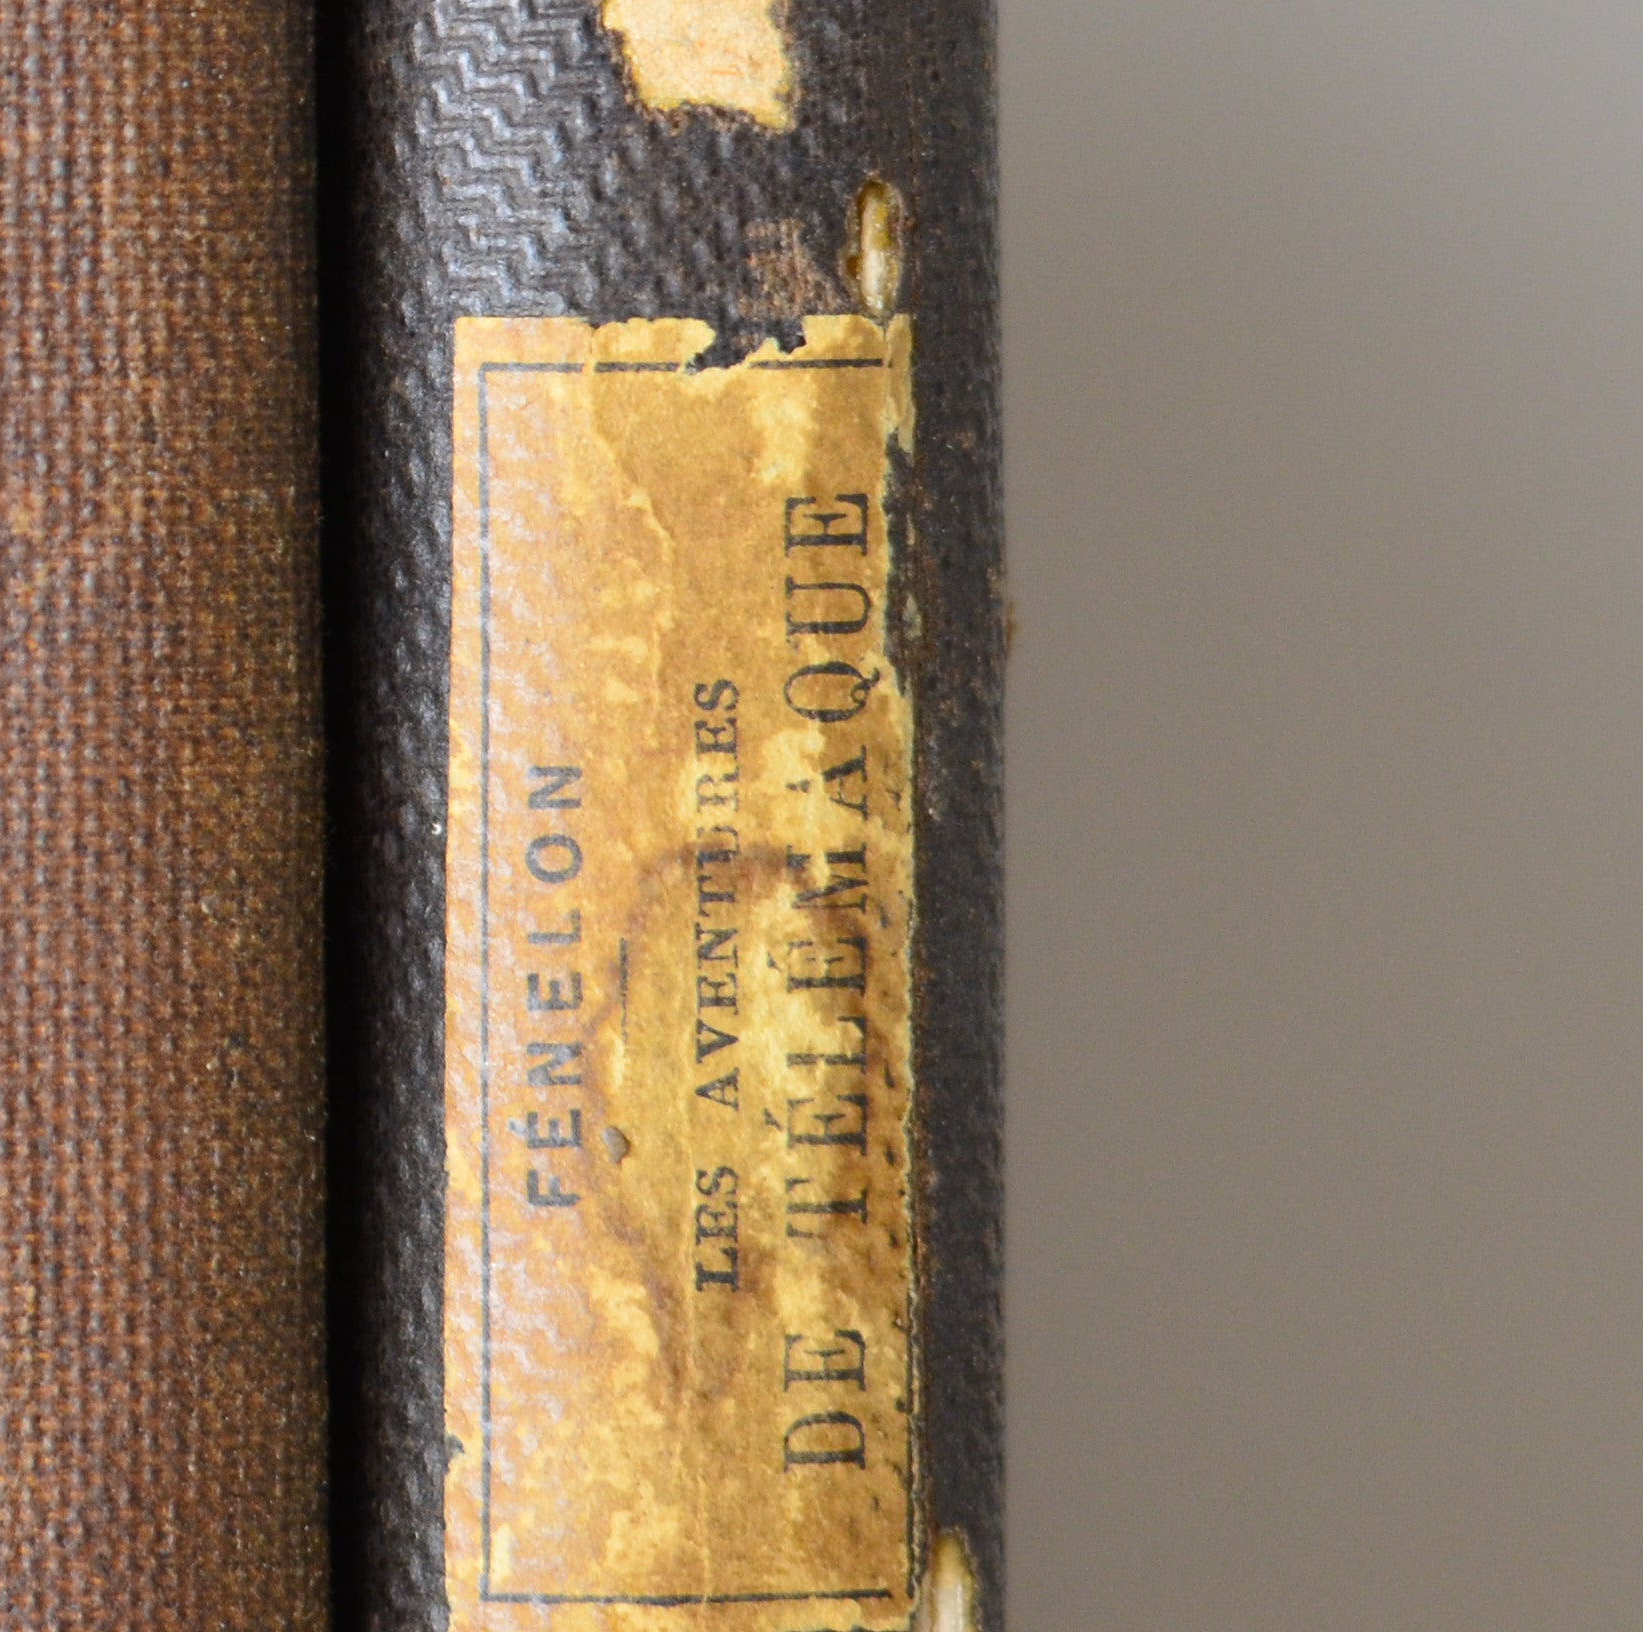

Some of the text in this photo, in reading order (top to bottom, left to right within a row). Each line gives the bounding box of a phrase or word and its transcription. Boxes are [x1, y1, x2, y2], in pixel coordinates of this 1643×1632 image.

[509, 764, 584, 1209] FÉNELON
[693, 677, 741, 1293] LES AVENTURES
[783, 1328, 868, 1474] DE
